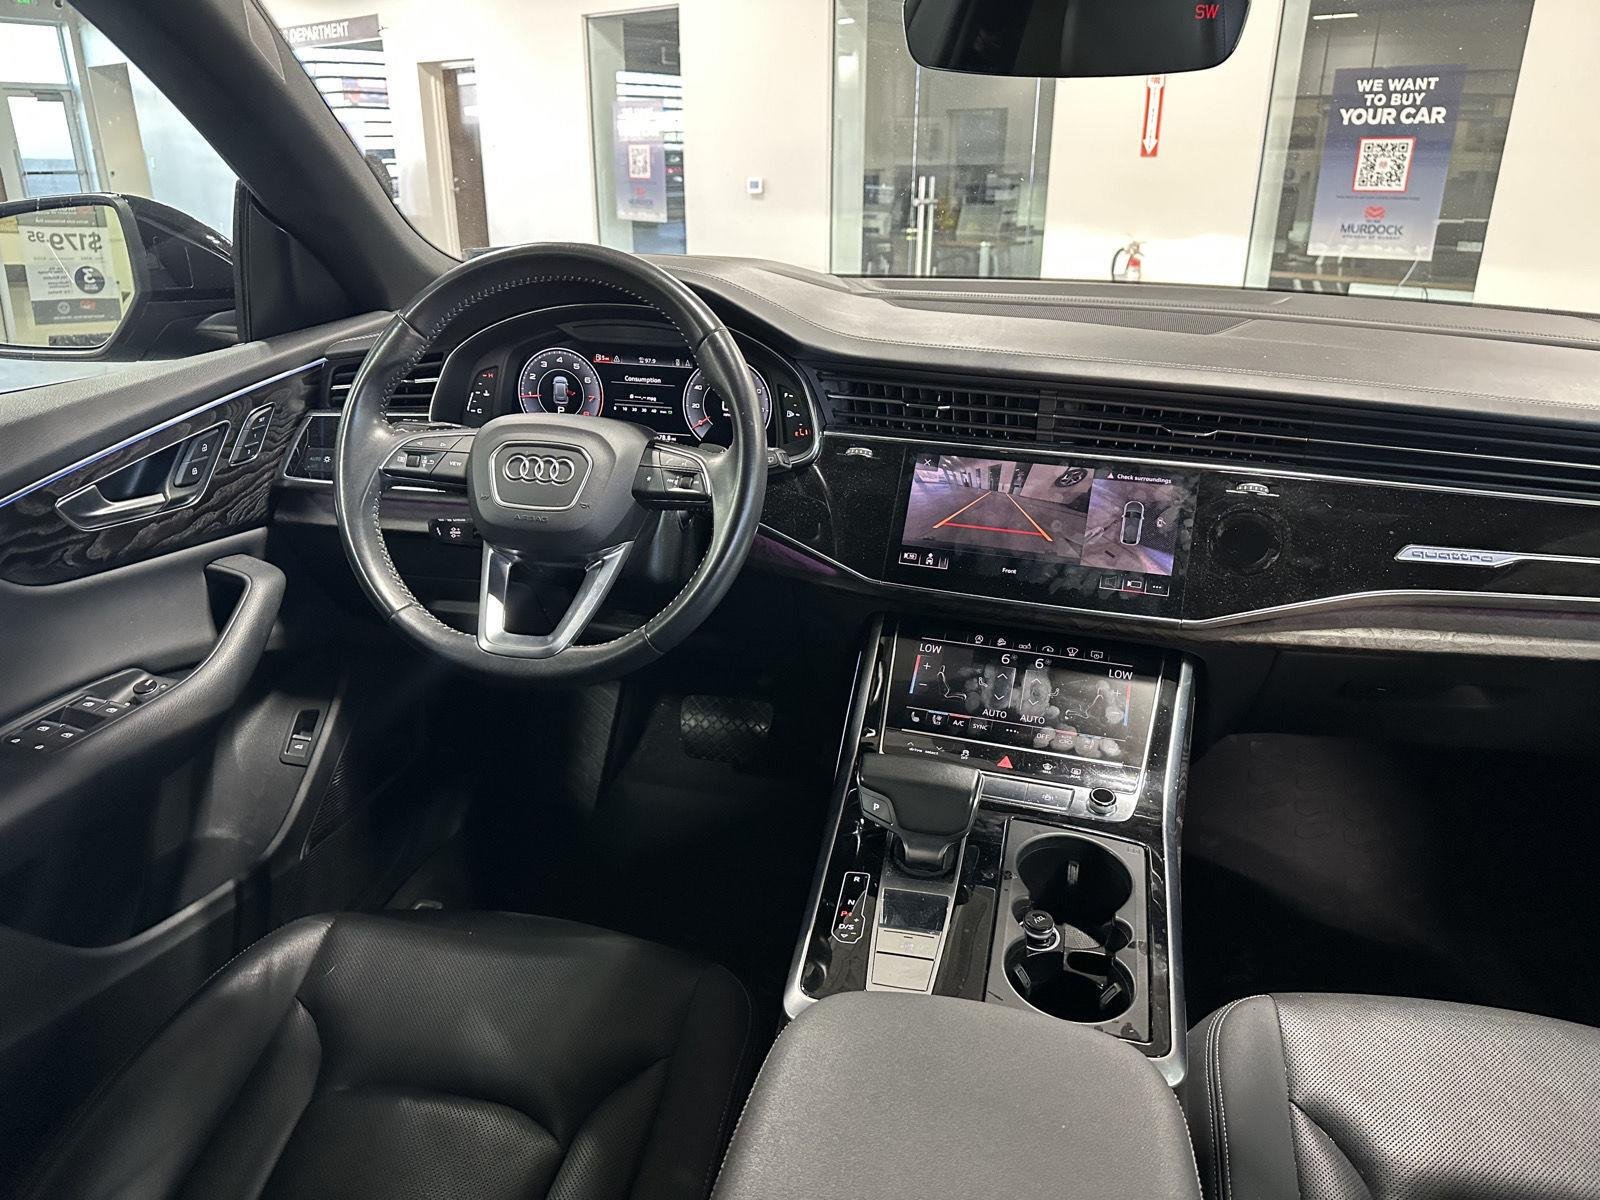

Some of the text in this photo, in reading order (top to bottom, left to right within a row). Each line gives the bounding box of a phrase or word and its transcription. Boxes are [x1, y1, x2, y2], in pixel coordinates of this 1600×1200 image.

[1194, 4, 1220, 20] SW
[289, 21, 350, 43] DEPARTMENT
[1356, 77, 1440, 92] WE WANT
[1364, 92, 1426, 106] TO BUY
[1340, 106, 1447, 126] YOUR CAR
[1340, 223, 1404, 236] MURDOCK
[624, 375, 662, 384] Consumption
[557, 406, 565, 415] P
[1117, 473, 1172, 484] Check surroundings
[1411, 550, 1494, 562] quattro
[1001, 567, 1017, 575] Front
[919, 643, 943, 655] LOW
[1001, 653, 1011, 665] 6
[1035, 658, 1045, 669] 6
[1108, 669, 1133, 681] LOW
[982, 708, 1008, 719] AUTO
[1019, 714, 1046, 725] AUTO
[952, 719, 988, 731] A/C SYNC
[1036, 732, 1050, 740] OFF
[872, 802, 880, 811] P
[838, 923, 855, 931] D/S
